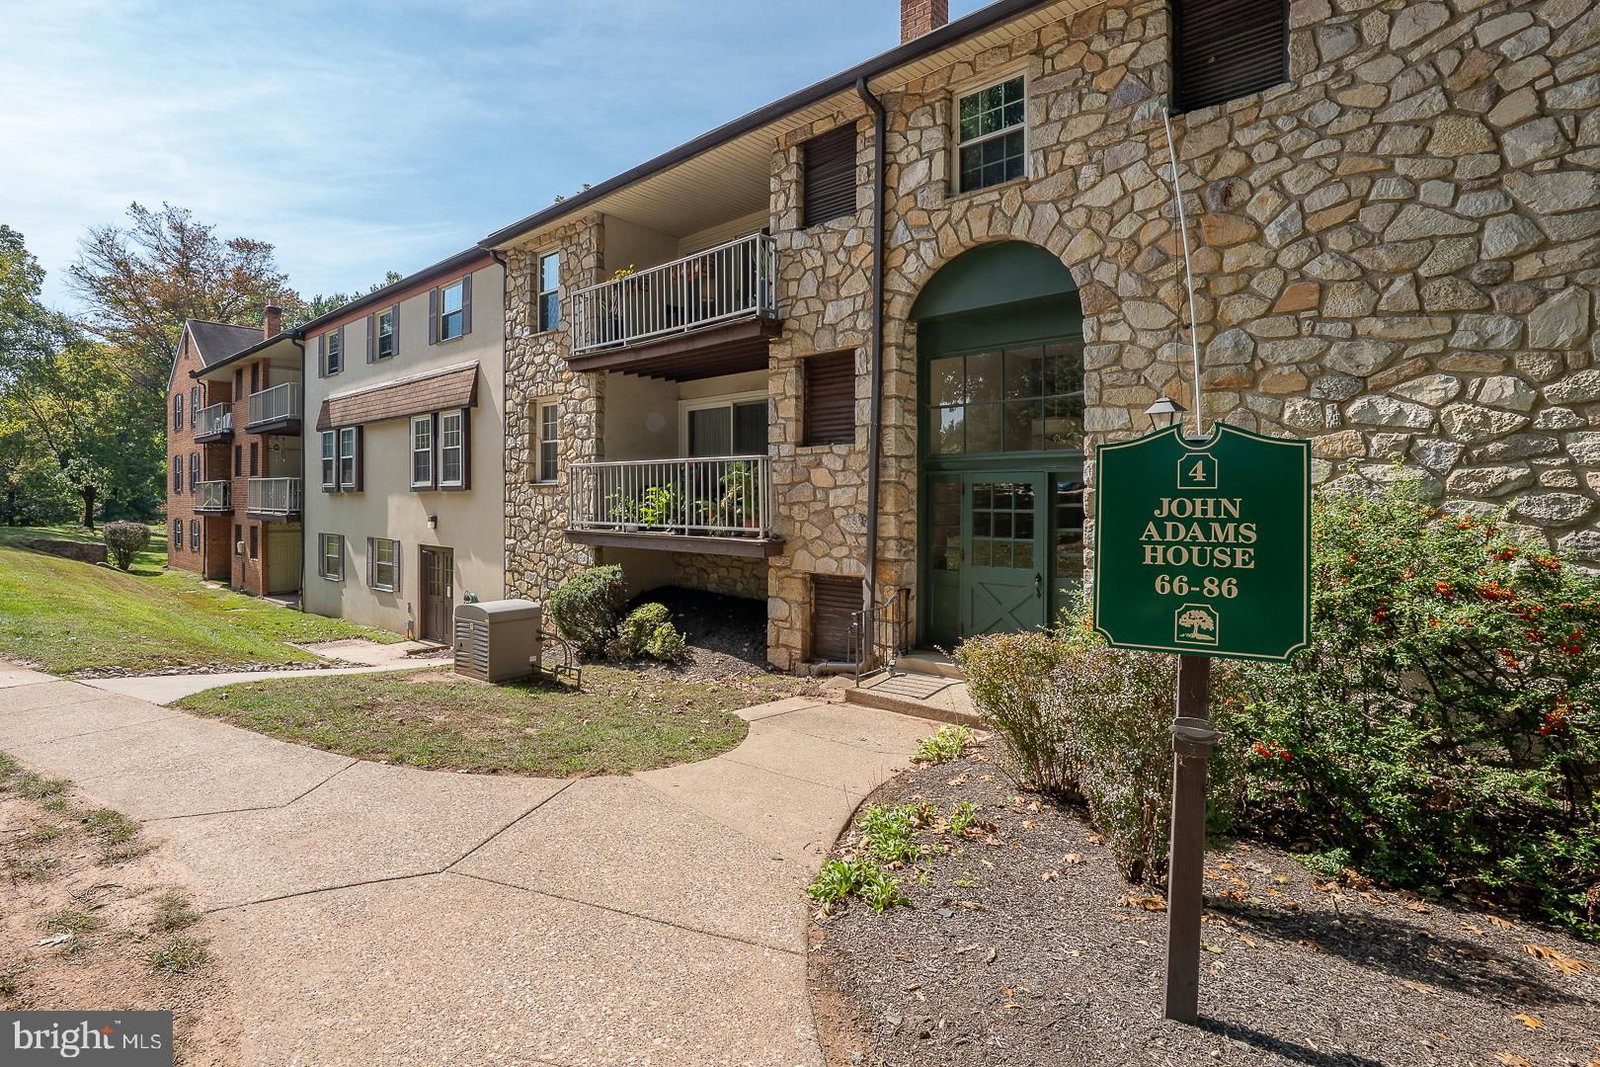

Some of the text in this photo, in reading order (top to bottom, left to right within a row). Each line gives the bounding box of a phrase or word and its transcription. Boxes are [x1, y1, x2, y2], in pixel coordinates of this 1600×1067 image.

[1188, 460, 1207, 482] 4
[1154, 497, 1242, 519] JOHN
[1139, 521, 1257, 544] ADAMS
[1142, 544, 1256, 569] HOUSE
[1154, 574, 1239, 599] 66-86
